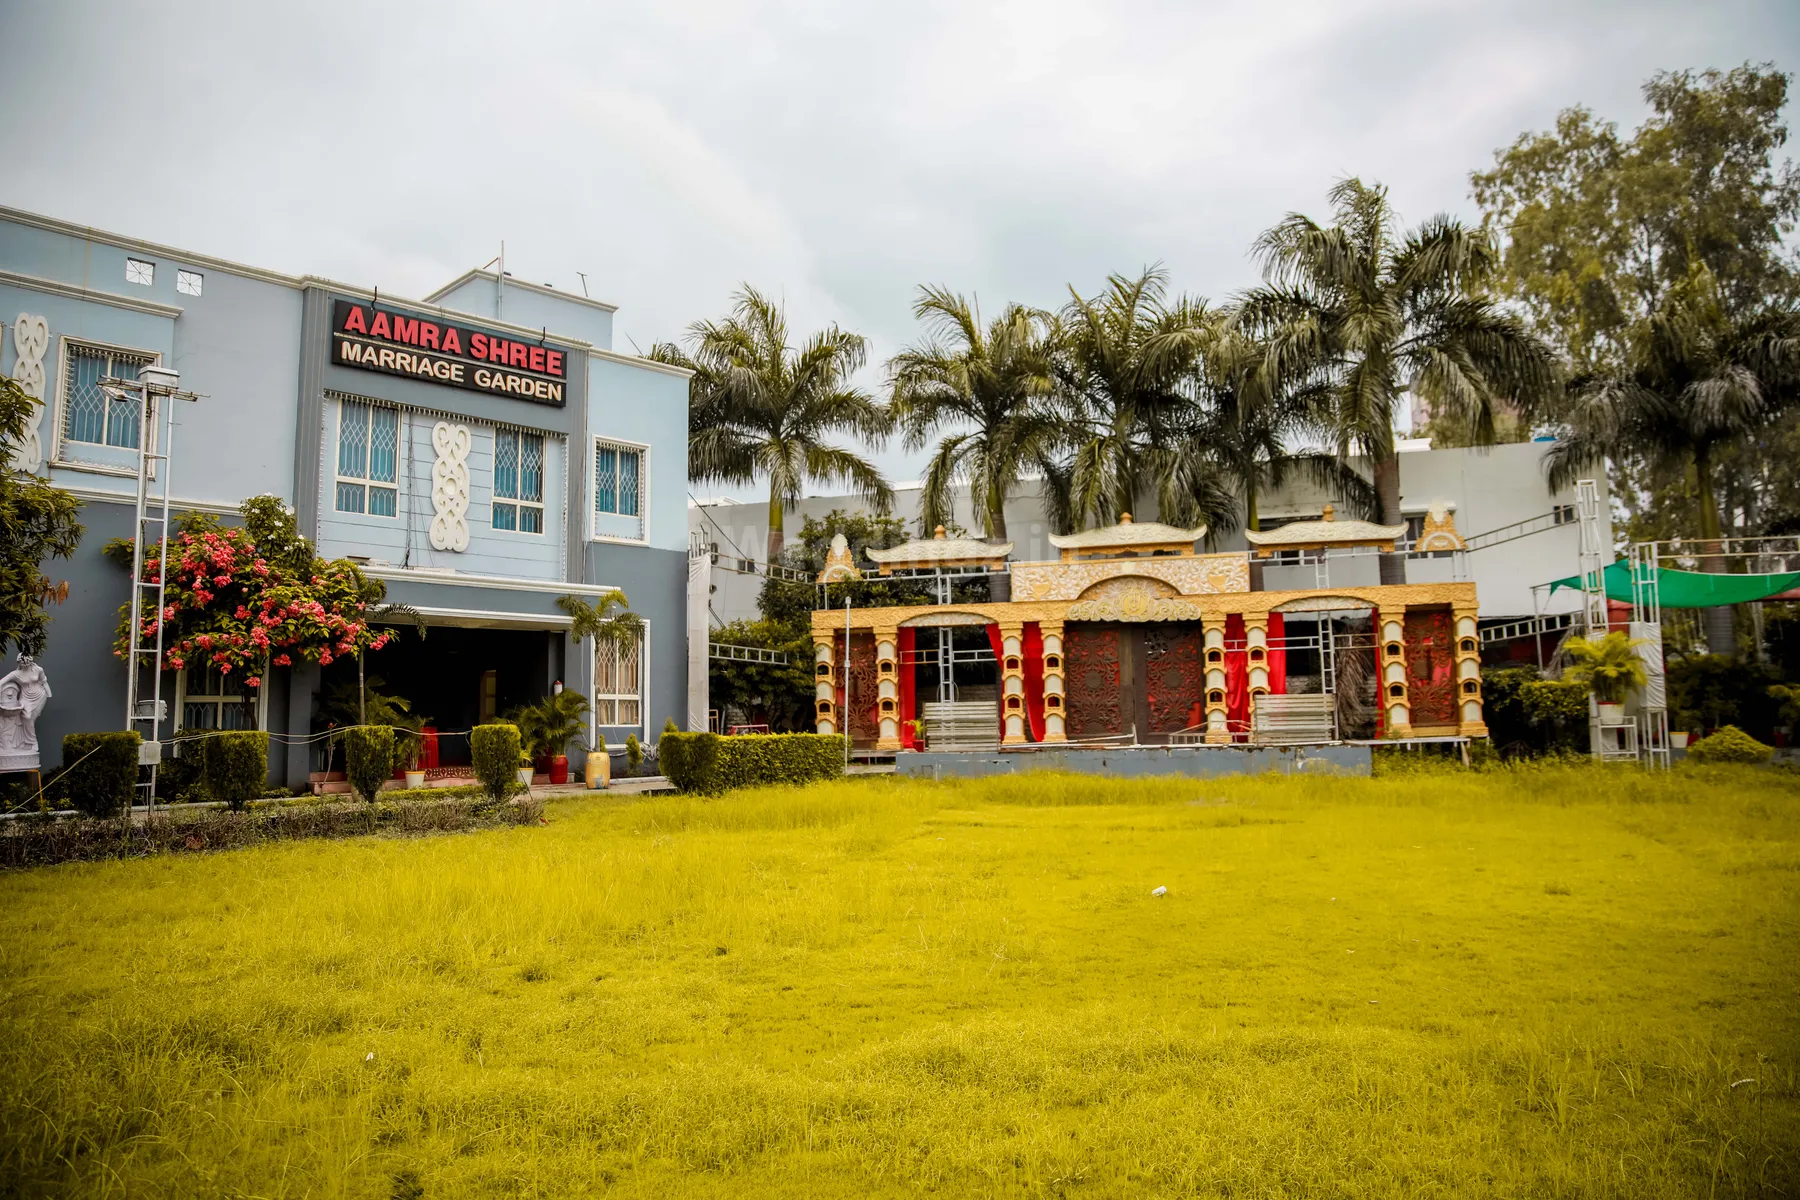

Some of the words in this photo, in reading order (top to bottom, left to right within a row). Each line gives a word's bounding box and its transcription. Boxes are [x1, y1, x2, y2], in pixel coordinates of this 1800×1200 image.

[341, 341, 464, 382] MARRIAGE
[474, 369, 562, 402] GARDEN
[344, 306, 462, 354] AAMRA
[470, 333, 563, 376] SHREE
